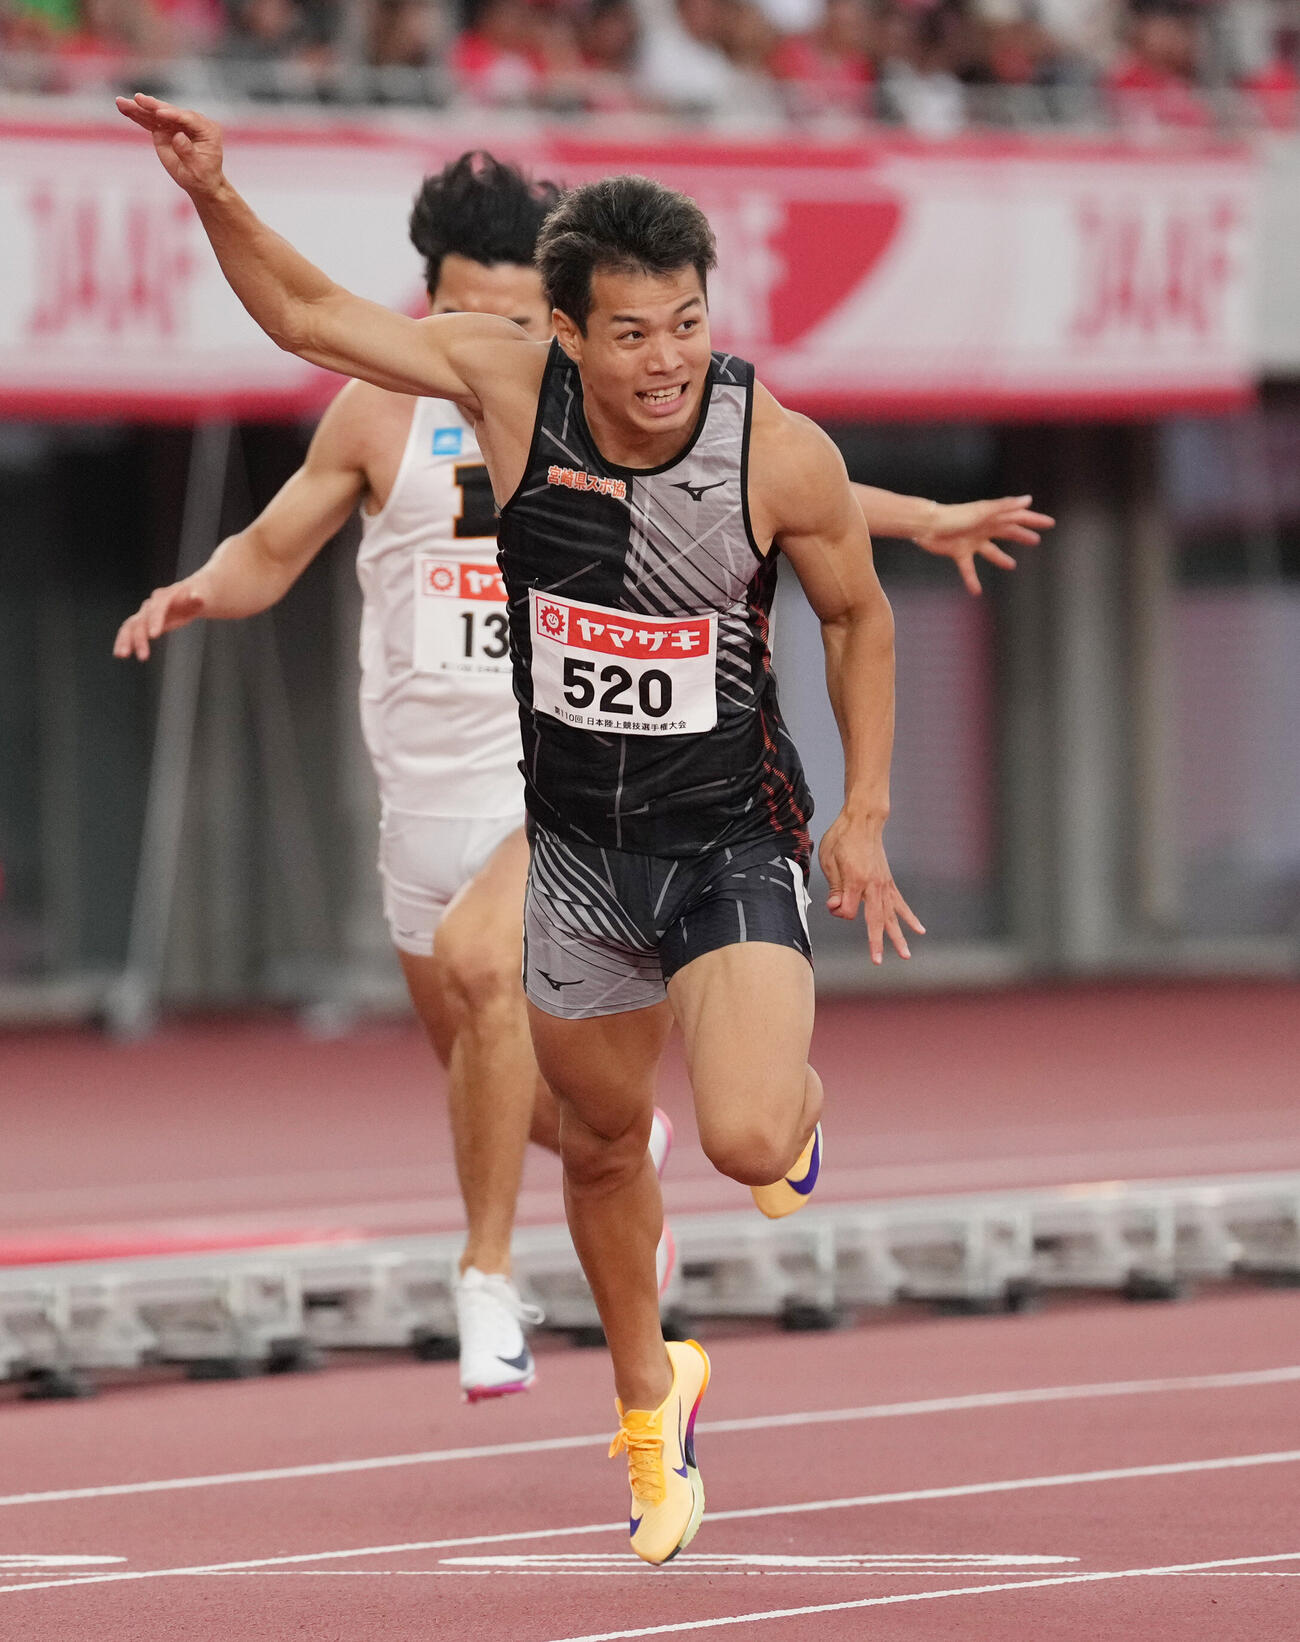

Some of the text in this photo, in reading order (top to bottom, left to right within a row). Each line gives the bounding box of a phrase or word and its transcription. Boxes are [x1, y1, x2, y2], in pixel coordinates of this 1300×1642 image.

[548, 465, 627, 499] 宮崎県スポ協
[576, 617, 701, 652] ヤマザキ
[563, 656, 673, 718] 520
[586, 716, 688, 732] 日本陸上競技選手権大会
